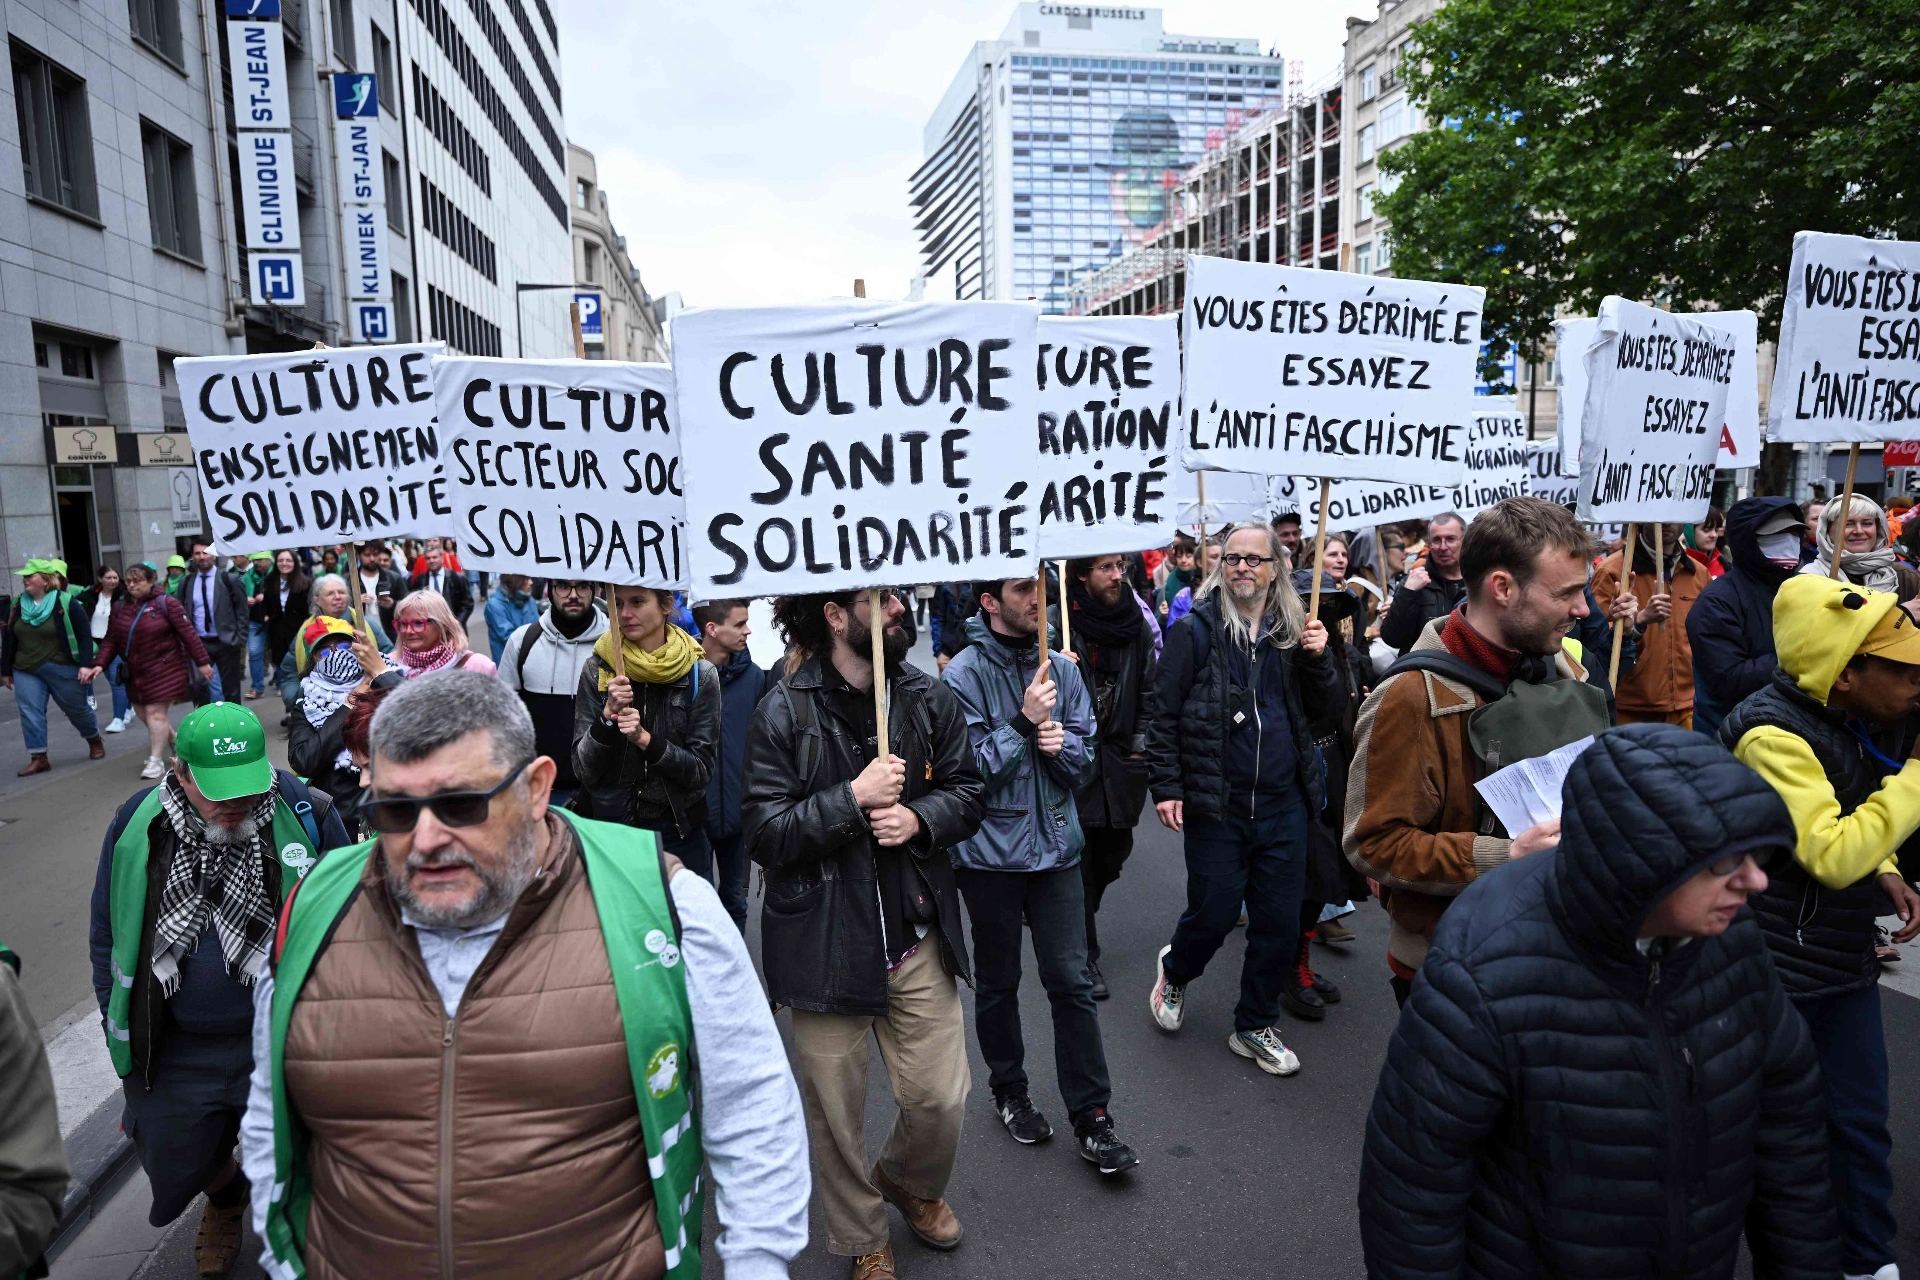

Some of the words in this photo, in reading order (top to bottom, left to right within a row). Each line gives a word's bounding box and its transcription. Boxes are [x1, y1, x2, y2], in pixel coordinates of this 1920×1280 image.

[1041, 5, 1081, 17] CARDO
[1087, 7, 1146, 20] BRUSSELS
[244, 26, 273, 122] ST-JEAN
[350, 125, 372, 198] ST-JAN
[254, 137, 283, 244] CLINIQUE
[358, 212, 379, 294] KLINIEK
[578, 297, 598, 324] P
[1194, 294, 1265, 332] VOUS
[1270, 285, 1330, 333] ÊTES
[1804, 263, 1859, 310] VOUS
[1859, 255, 1907, 312] ÊTES
[1617, 329, 1645, 369] VOUS
[1859, 315, 1920, 362] ESSA
[199, 353, 434, 424] CULTURE
[718, 338, 1014, 420] CULTURE
[1283, 353, 1431, 390] ESSAYEZ
[463, 378, 671, 434] CULTUR
[1643, 395, 1709, 434] ESSAYEZ
[200, 417, 439, 489] ENSEIGNEMEN
[453, 438, 607, 490] SECTEUR
[750, 407, 972, 505] SANTÉ
[1284, 412, 1464, 462] FASCHISME
[215, 465, 452, 541] SOLIDARITÉ
[467, 504, 685, 582] SOLIDARI
[708, 481, 1030, 585] SOLIDARITÉ
[227, 740, 247, 751] ACV
